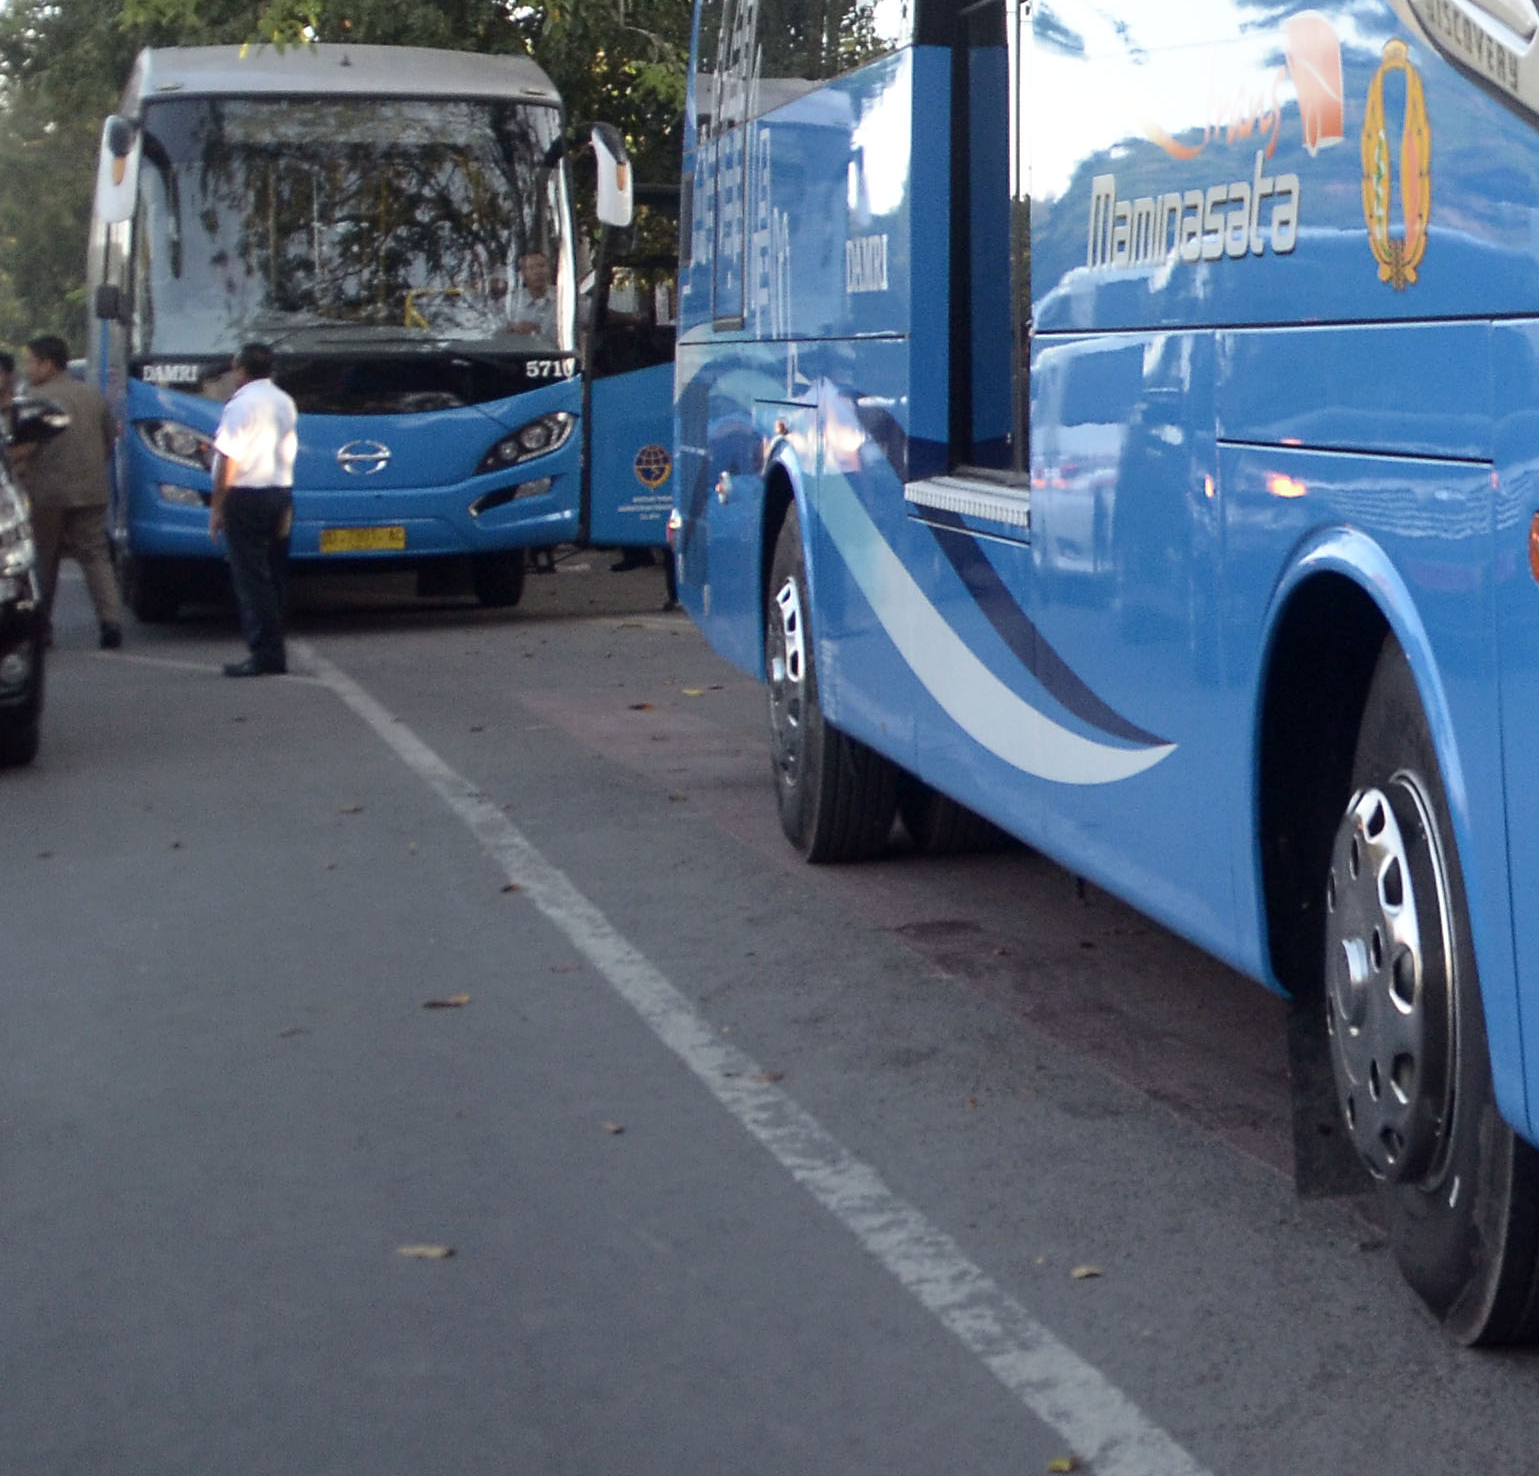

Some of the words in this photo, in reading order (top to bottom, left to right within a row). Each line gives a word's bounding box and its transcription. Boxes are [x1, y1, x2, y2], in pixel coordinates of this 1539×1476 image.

[1087, 148, 1300, 273] Maminasata
[846, 234, 889, 293] DAMRI
[143, 365, 199, 382] DAMRI
